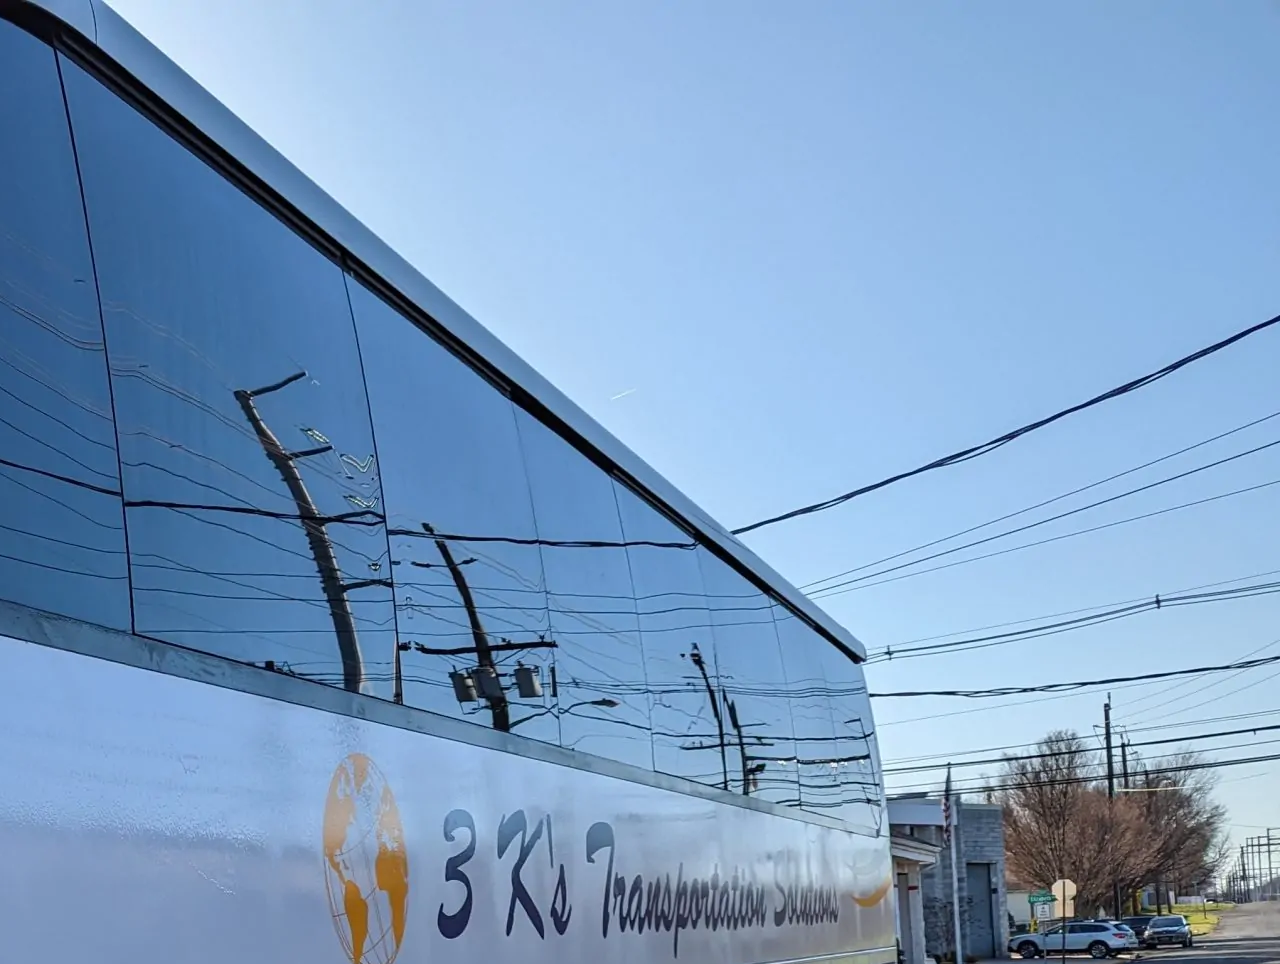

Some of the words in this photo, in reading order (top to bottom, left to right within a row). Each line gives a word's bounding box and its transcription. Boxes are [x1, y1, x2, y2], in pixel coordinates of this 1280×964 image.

[437, 808, 477, 940] 3
[497, 808, 573, 941] K's
[586, 821, 768, 959] Transportation
[774, 848, 840, 928] Solutions
